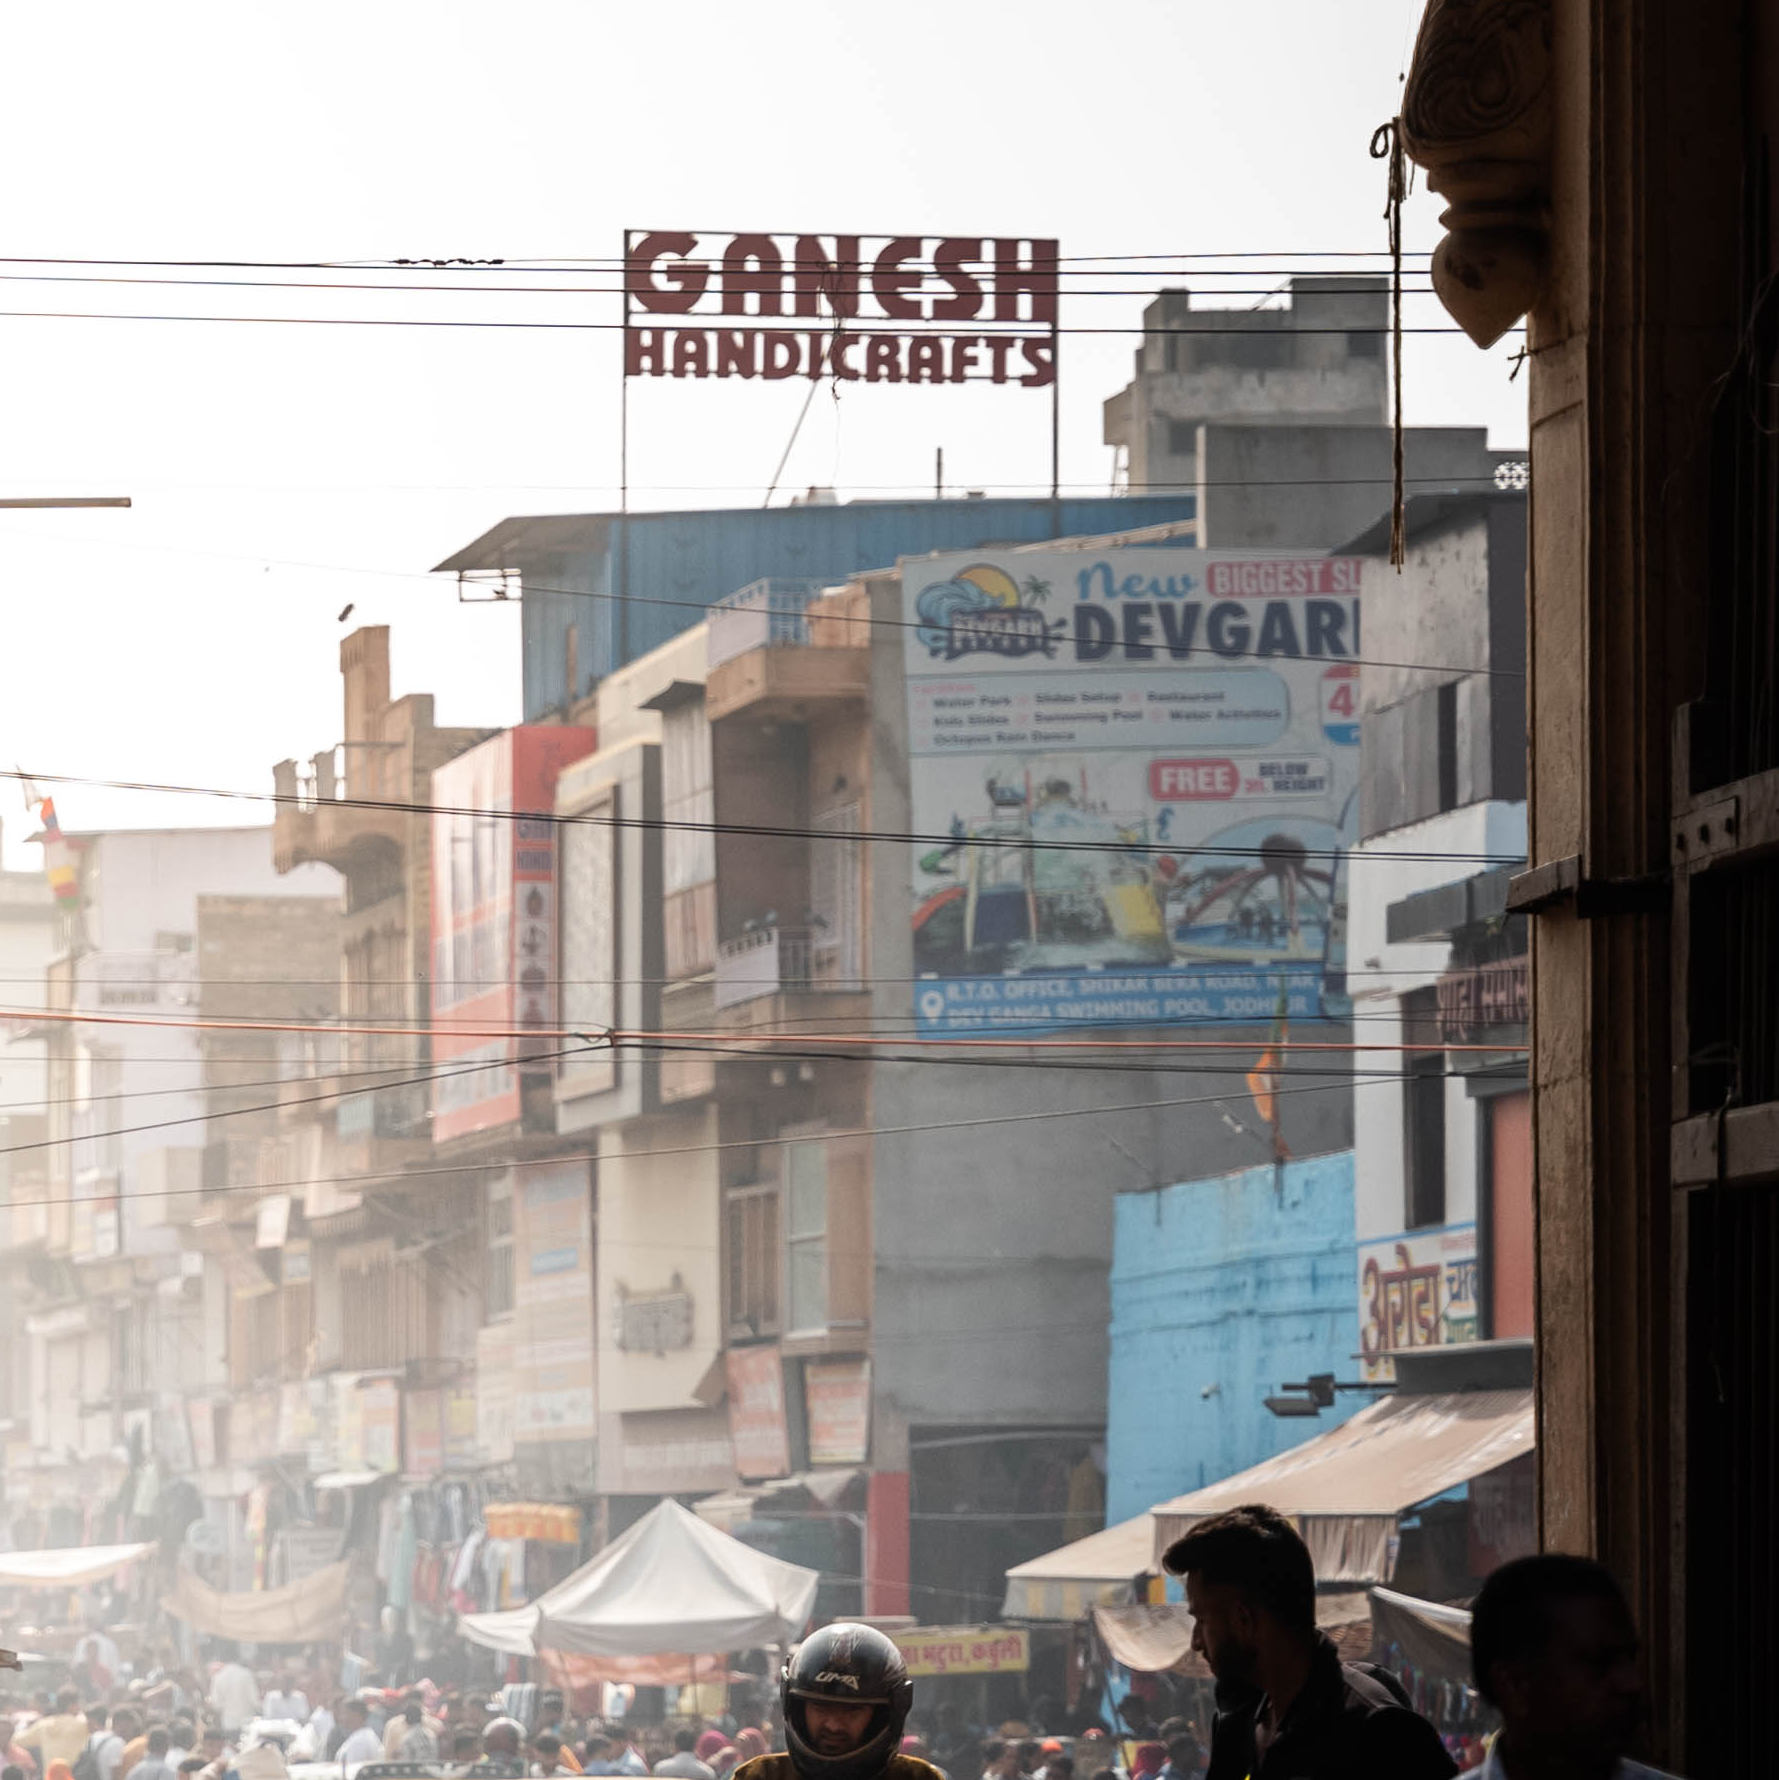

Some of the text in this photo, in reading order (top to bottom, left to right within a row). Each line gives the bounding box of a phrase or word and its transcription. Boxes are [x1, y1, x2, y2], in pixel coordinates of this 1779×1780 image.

[629, 231, 1058, 322] GANESH
[628, 327, 1053, 387] HANDICRAFTS
[1076, 561, 1198, 601] New
[1214, 560, 1360, 594] BIGGEST SL
[1073, 598, 1360, 663] DEVGAR
[1159, 766, 1232, 794] FREE
[1259, 762, 1308, 776] BELOW
[1273, 777, 1324, 790] HEIGHT
[1267, 972, 1314, 987] NAR
[1223, 995, 1307, 1014] JODHUR
